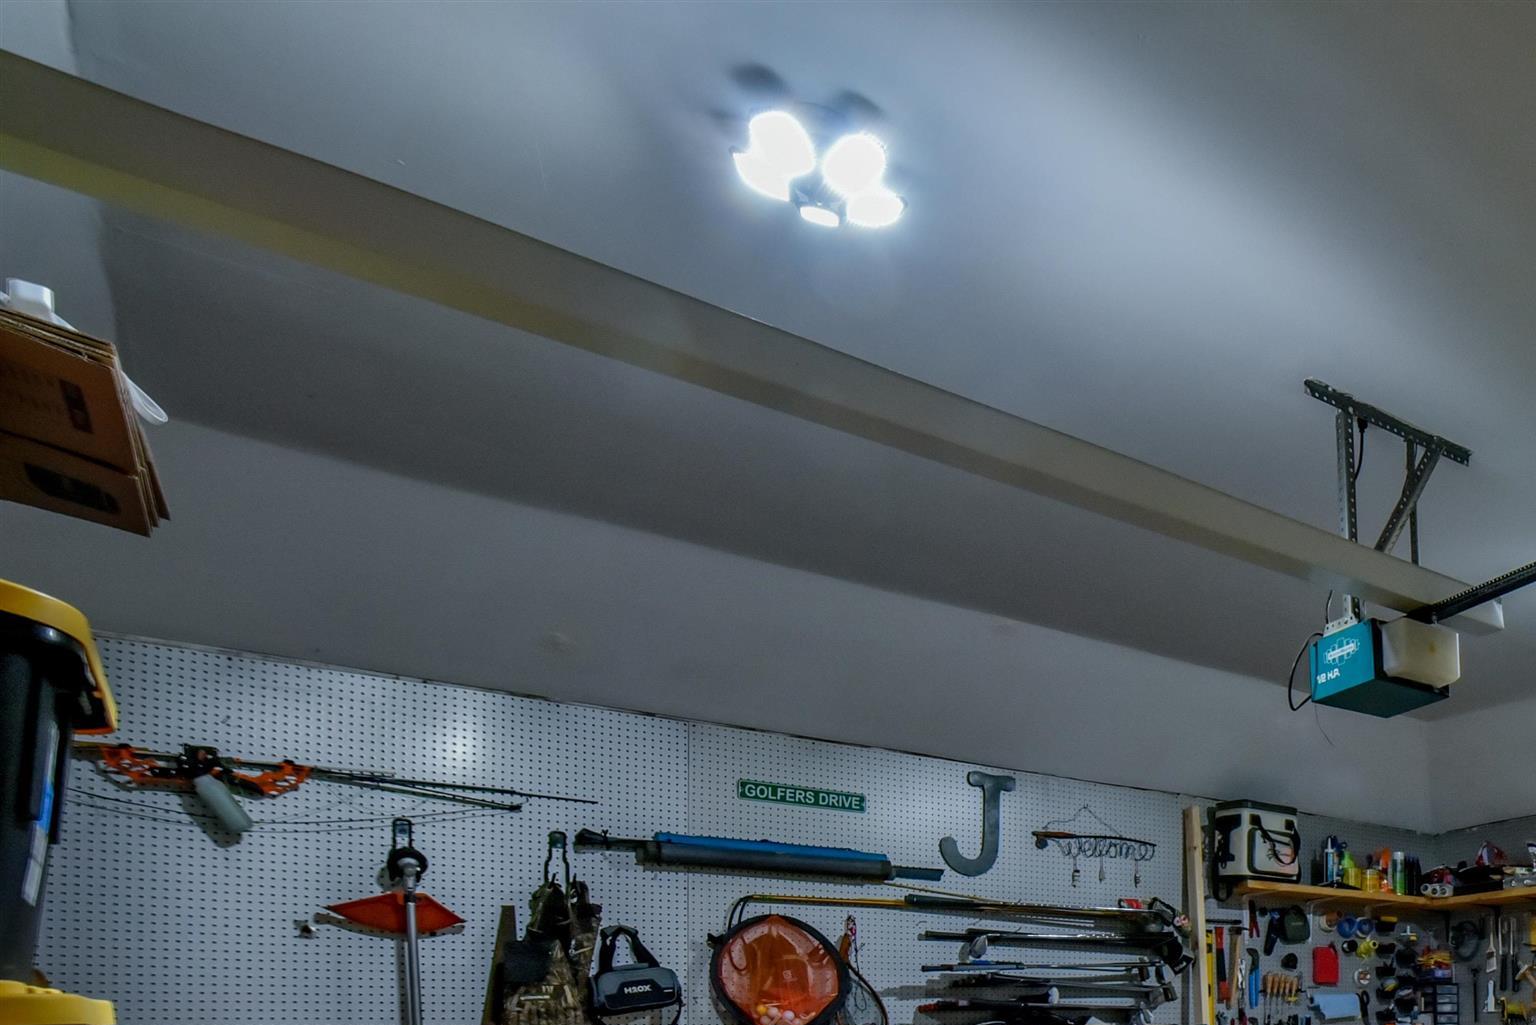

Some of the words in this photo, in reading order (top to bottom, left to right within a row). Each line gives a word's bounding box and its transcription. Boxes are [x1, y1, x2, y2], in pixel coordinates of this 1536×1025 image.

[744, 784, 815, 804] GOLFERS
[819, 793, 861, 809] DRIVE
[939, 771, 1016, 877] J
